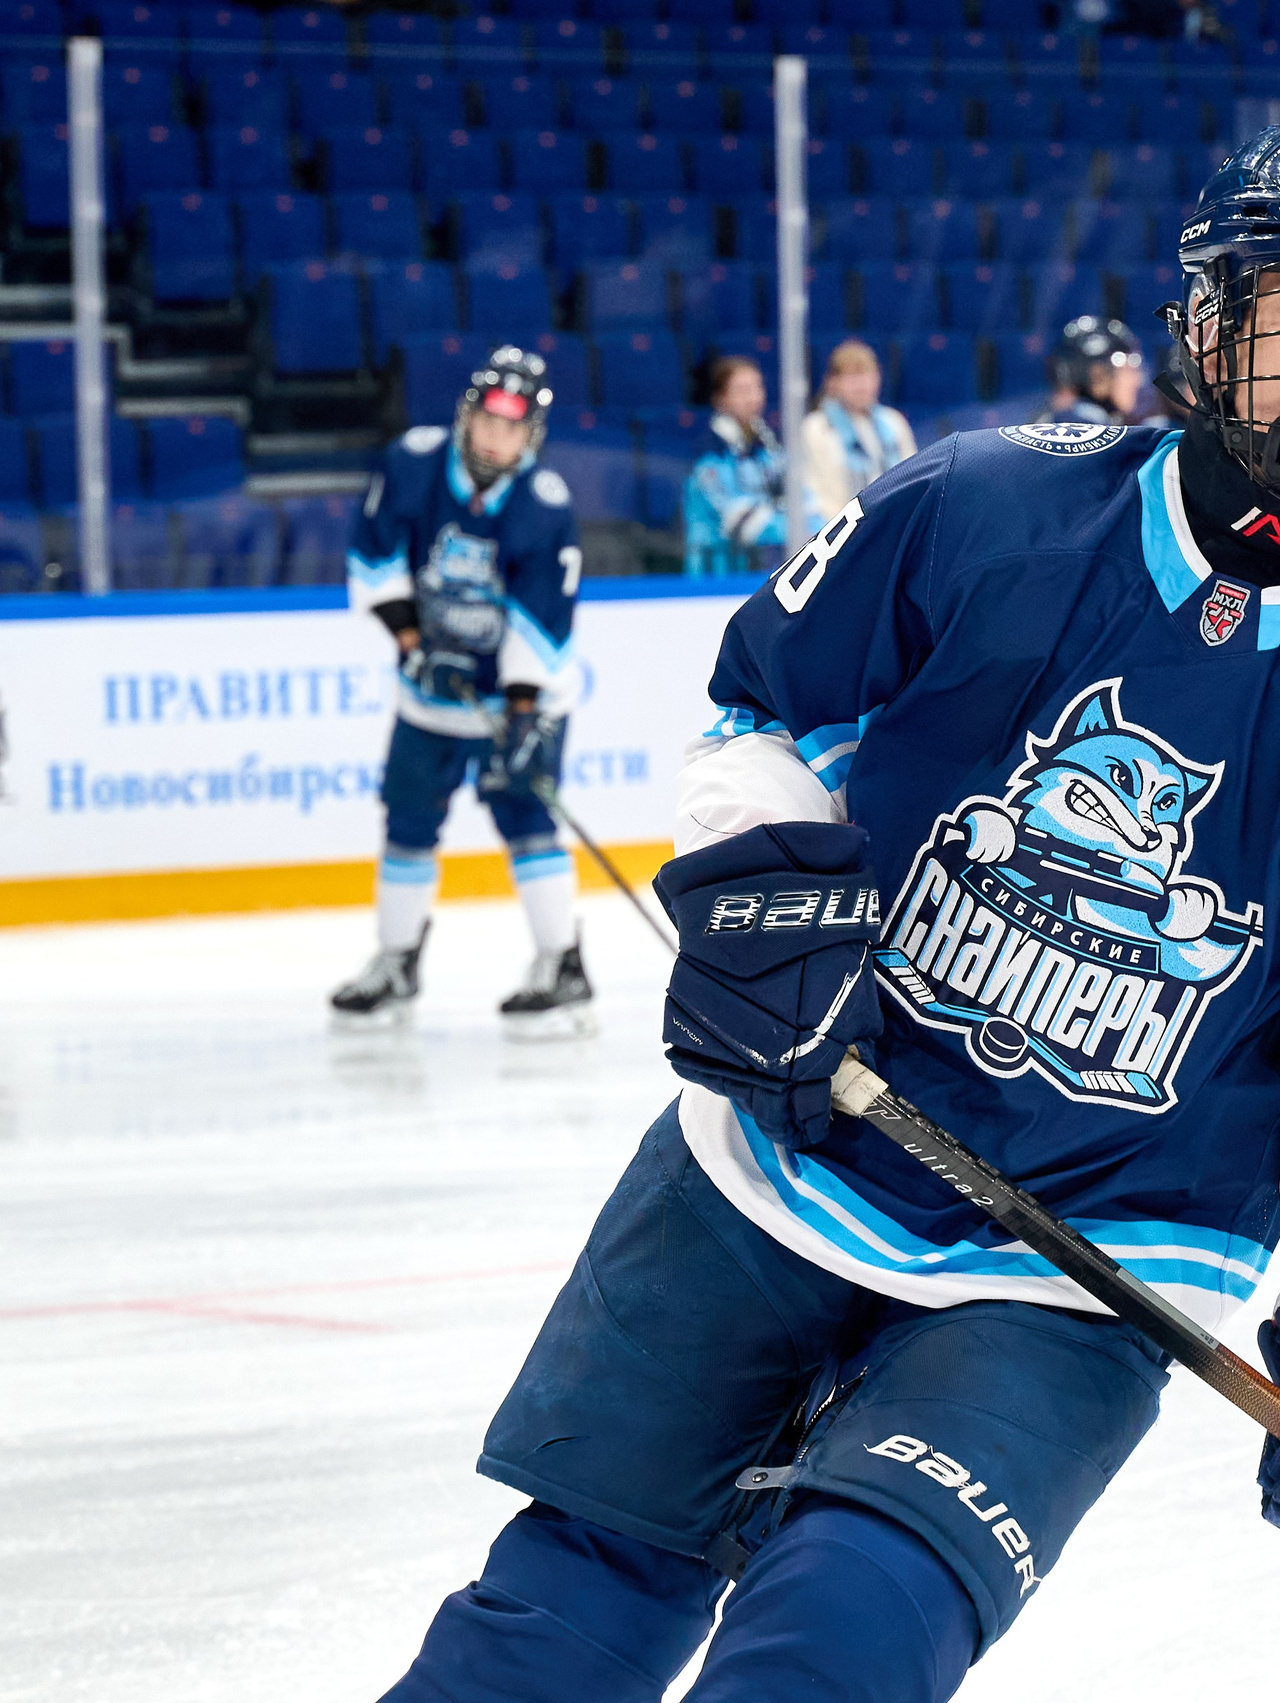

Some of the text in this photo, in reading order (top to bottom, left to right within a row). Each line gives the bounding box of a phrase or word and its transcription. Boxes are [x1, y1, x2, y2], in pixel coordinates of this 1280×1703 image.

[1180, 219, 1212, 244] CCM
[1195, 303, 1220, 325] CCM
[769, 496, 865, 614] 8
[1212, 592, 1243, 611] МХЛ
[981, 878, 1142, 964] СИБИРСКИЕ
[862, 1434, 1042, 1599] BAUER
